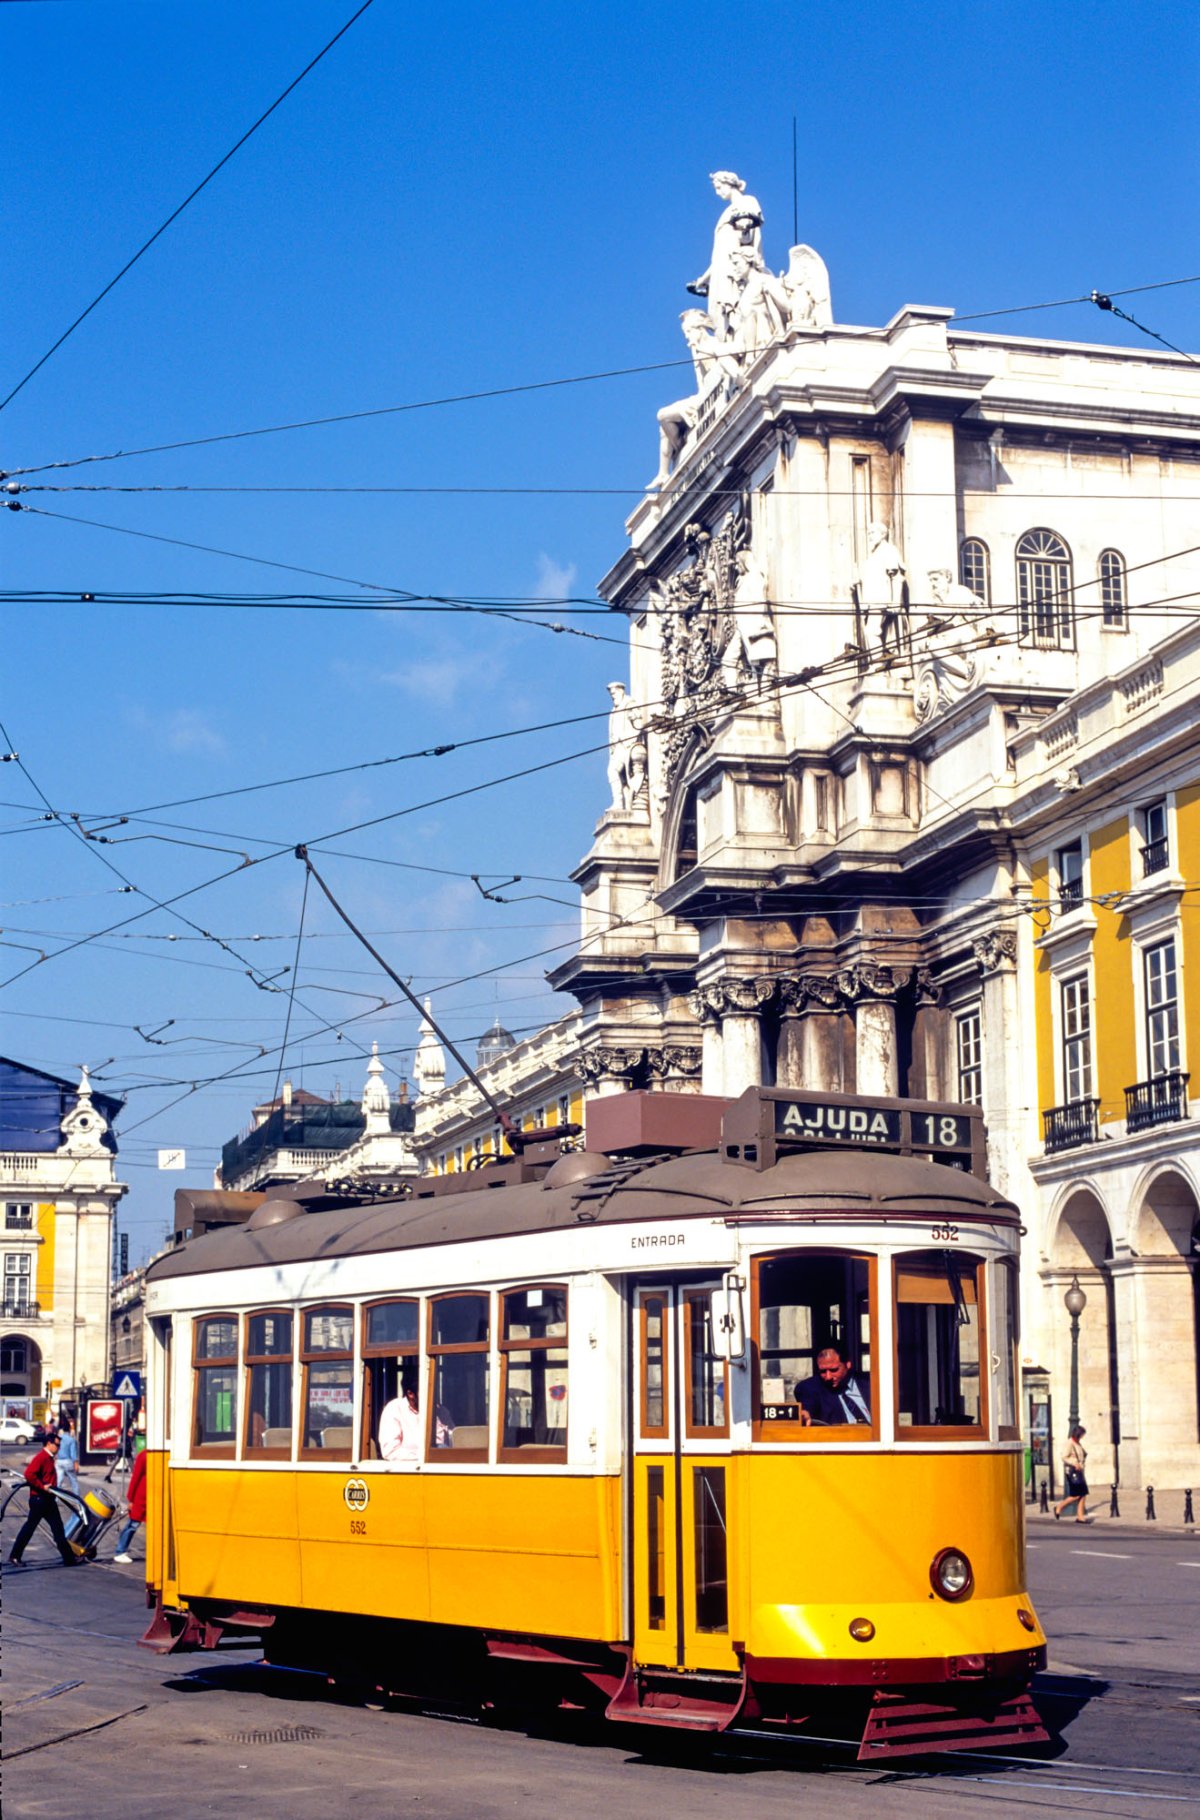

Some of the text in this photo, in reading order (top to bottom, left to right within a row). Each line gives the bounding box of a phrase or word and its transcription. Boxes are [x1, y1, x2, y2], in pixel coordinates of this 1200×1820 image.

[783, 1105, 957, 1146] AJUDA 18
[932, 1224, 959, 1241] 552
[631, 1234, 685, 1248] ENTRADA
[350, 1520, 367, 1535] 552
